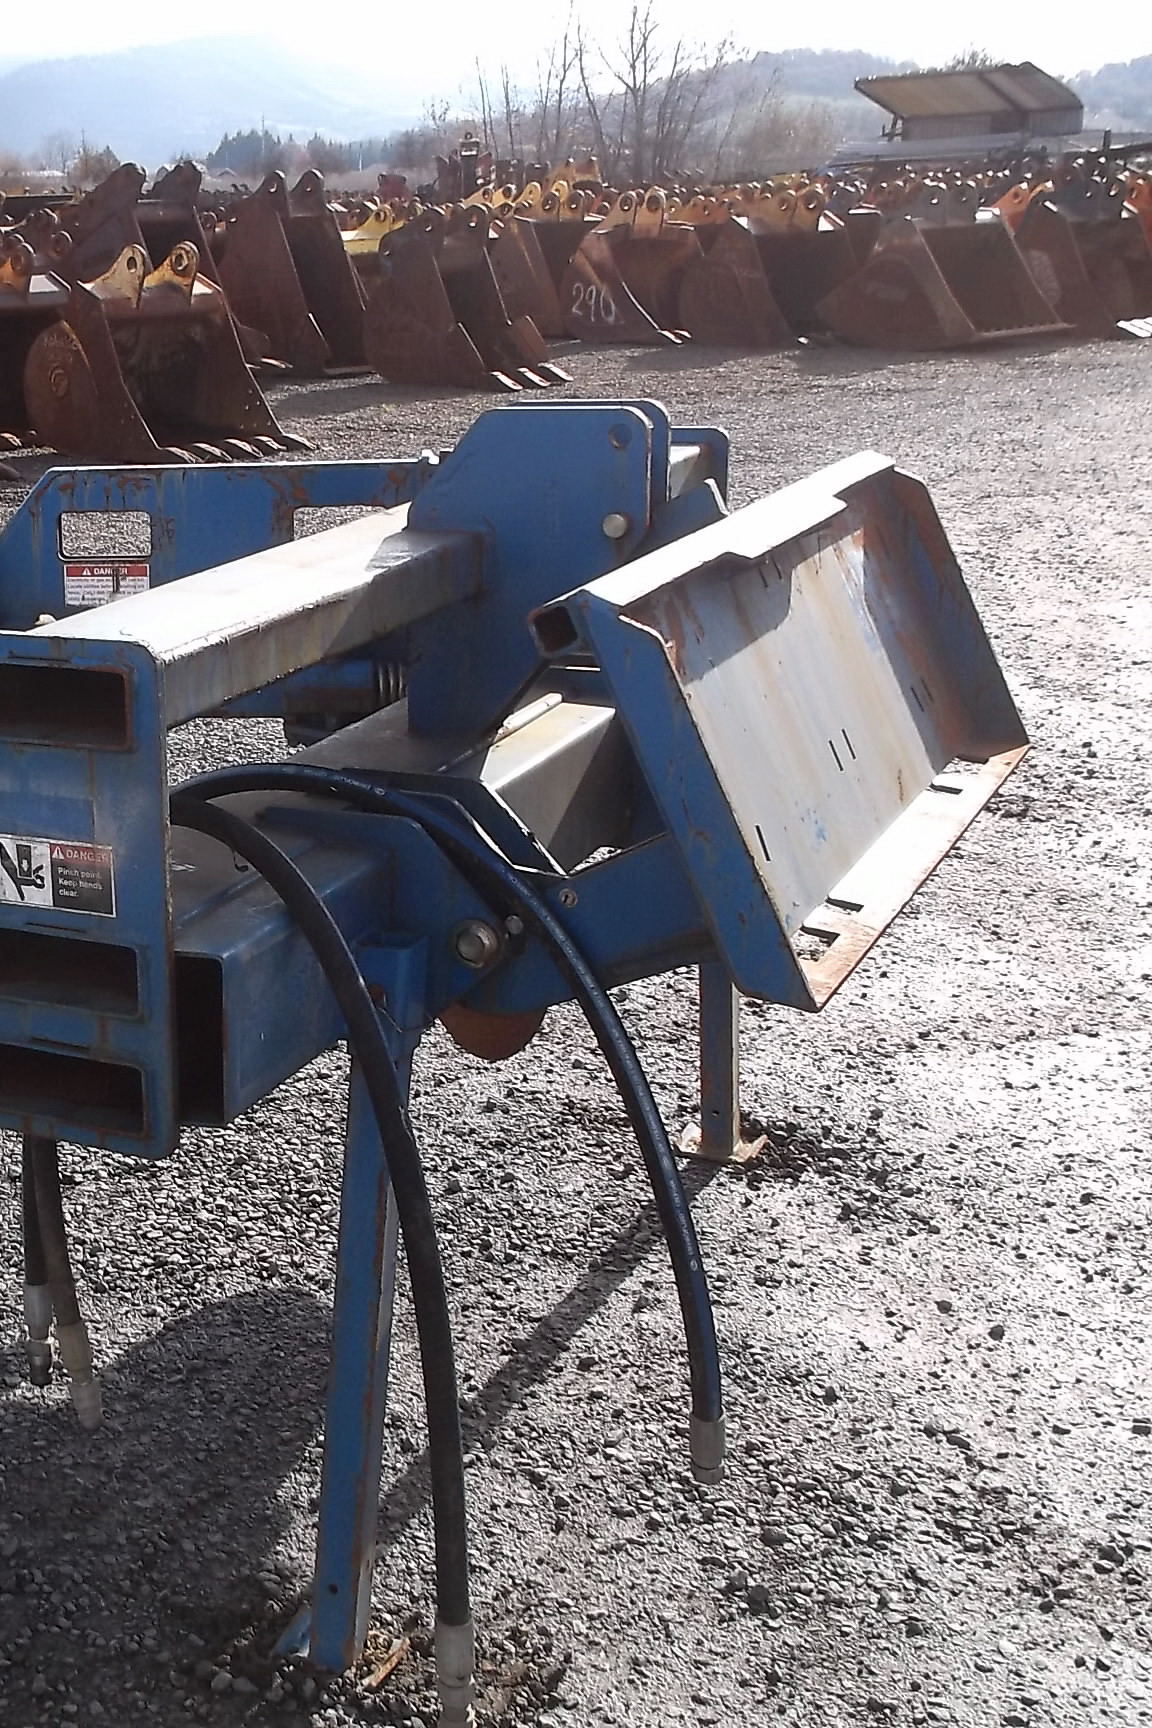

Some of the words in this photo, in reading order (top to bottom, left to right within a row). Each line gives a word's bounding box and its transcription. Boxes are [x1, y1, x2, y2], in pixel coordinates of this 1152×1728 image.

[66, 849, 106, 863] DANGER
[58, 866, 79, 877] Pinch
[58, 877, 78, 888] Keep
